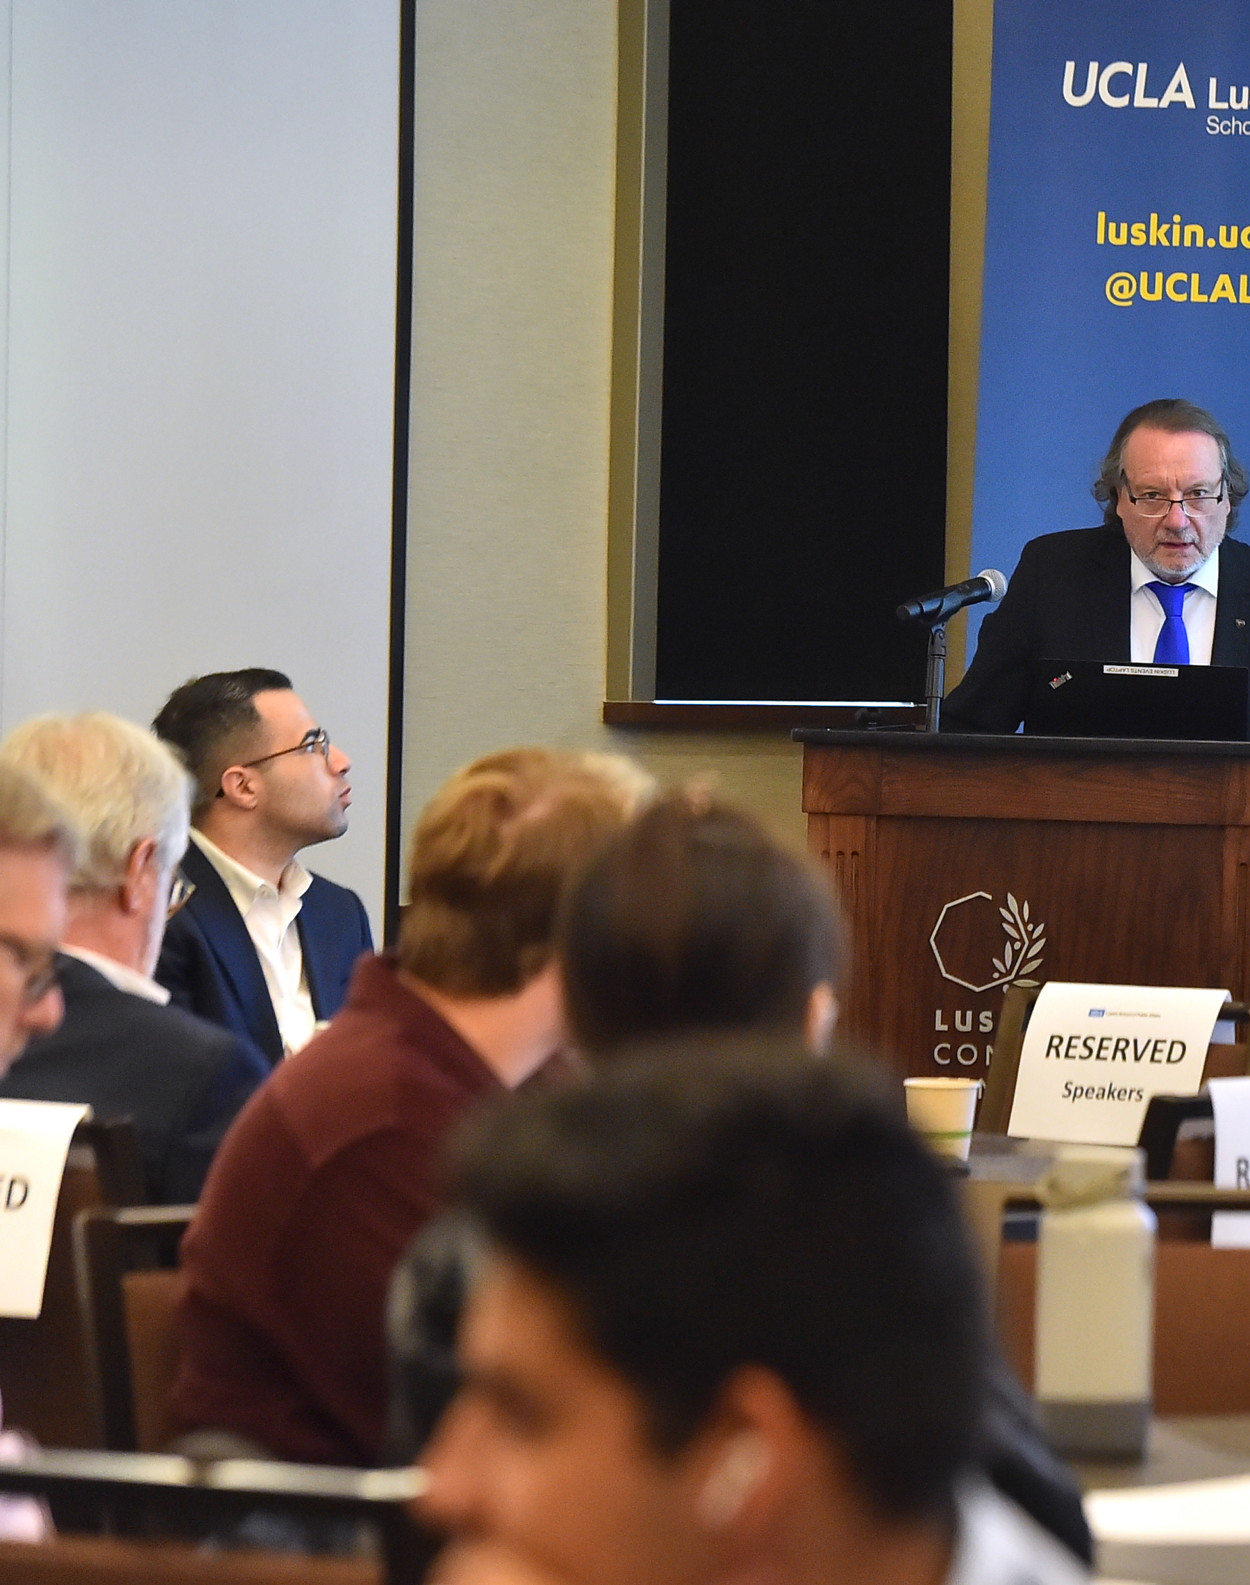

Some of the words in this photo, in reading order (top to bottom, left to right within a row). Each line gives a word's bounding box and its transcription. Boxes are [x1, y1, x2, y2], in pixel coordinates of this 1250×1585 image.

[1062, 60, 1196, 109] UCLA
[935, 1009, 993, 1033] LUS
[1045, 1034, 1187, 1064] RESERVED
[1062, 1081, 1143, 1103] Speakers
[0, 1176, 29, 1210] D
